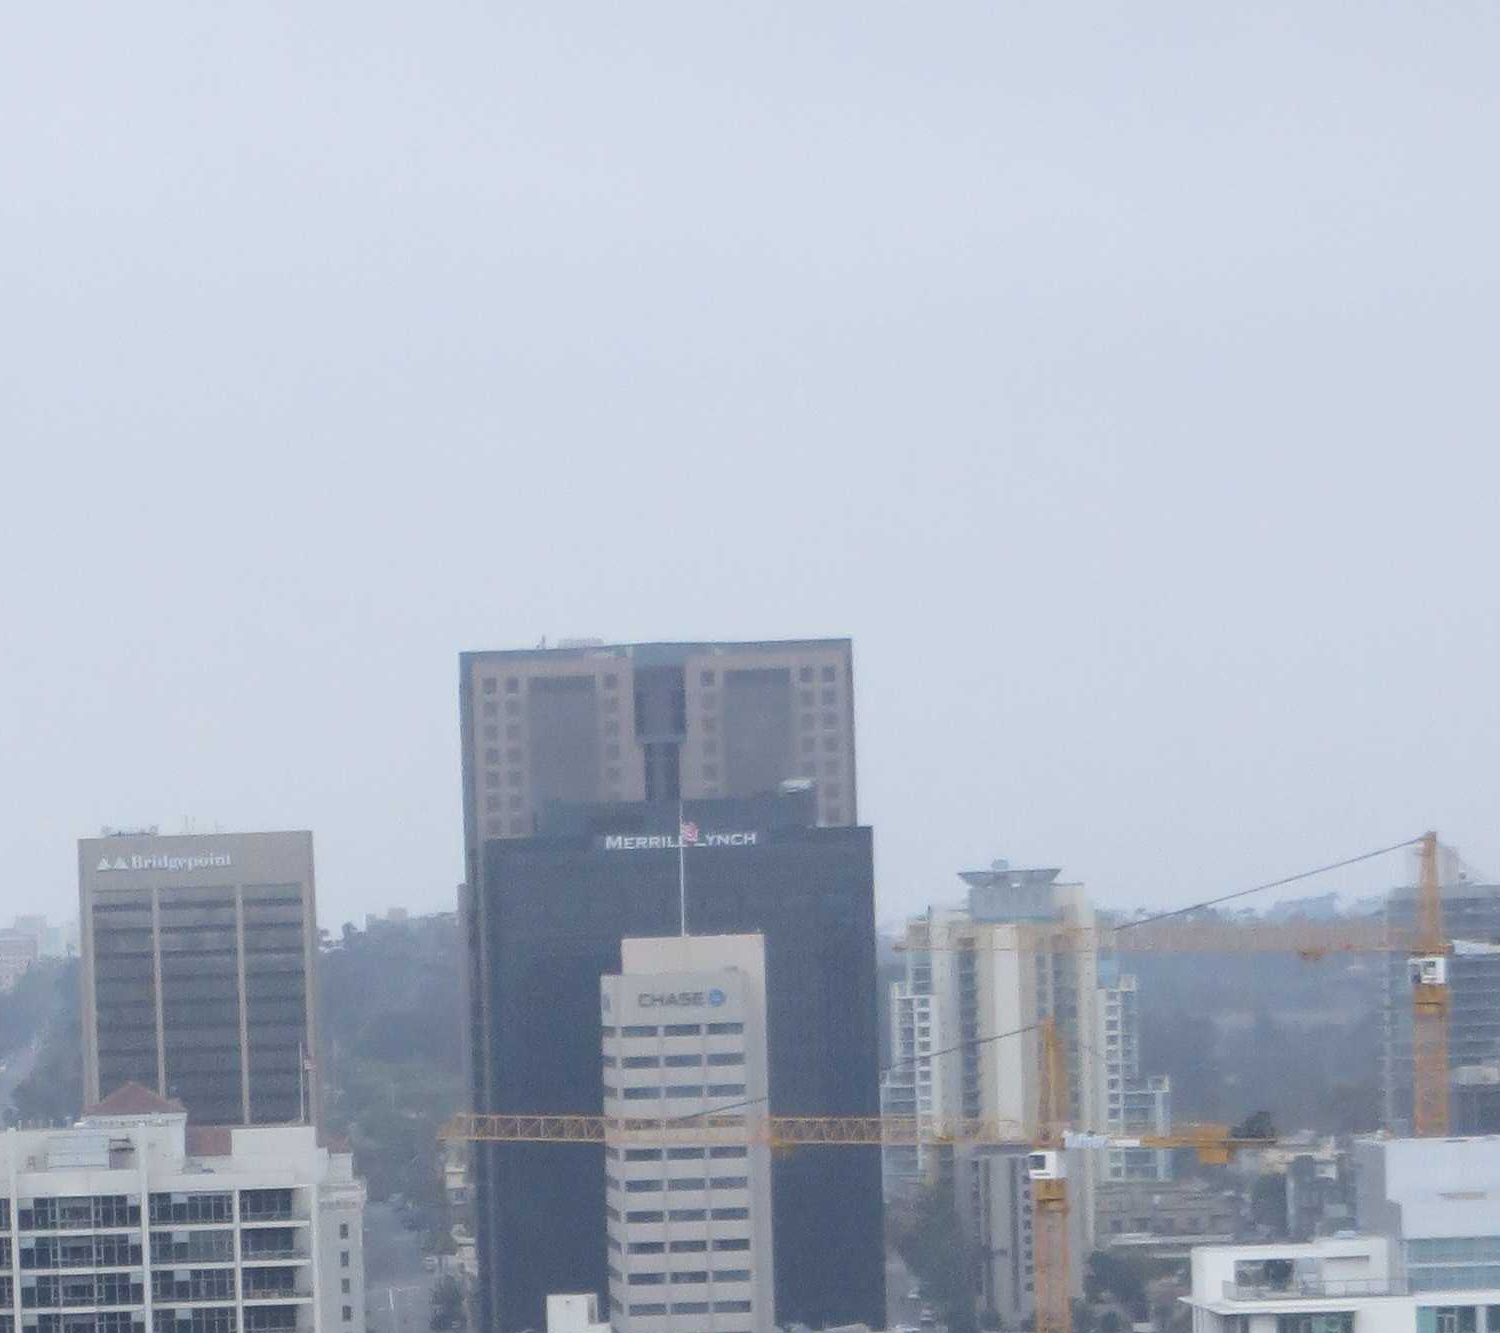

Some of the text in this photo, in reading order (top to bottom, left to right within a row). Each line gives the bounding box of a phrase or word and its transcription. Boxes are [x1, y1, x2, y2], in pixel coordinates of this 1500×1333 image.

[694, 832, 758, 847] YNCH
[131, 852, 232, 872] Bridgepoint
[638, 991, 706, 1008] CHASE
